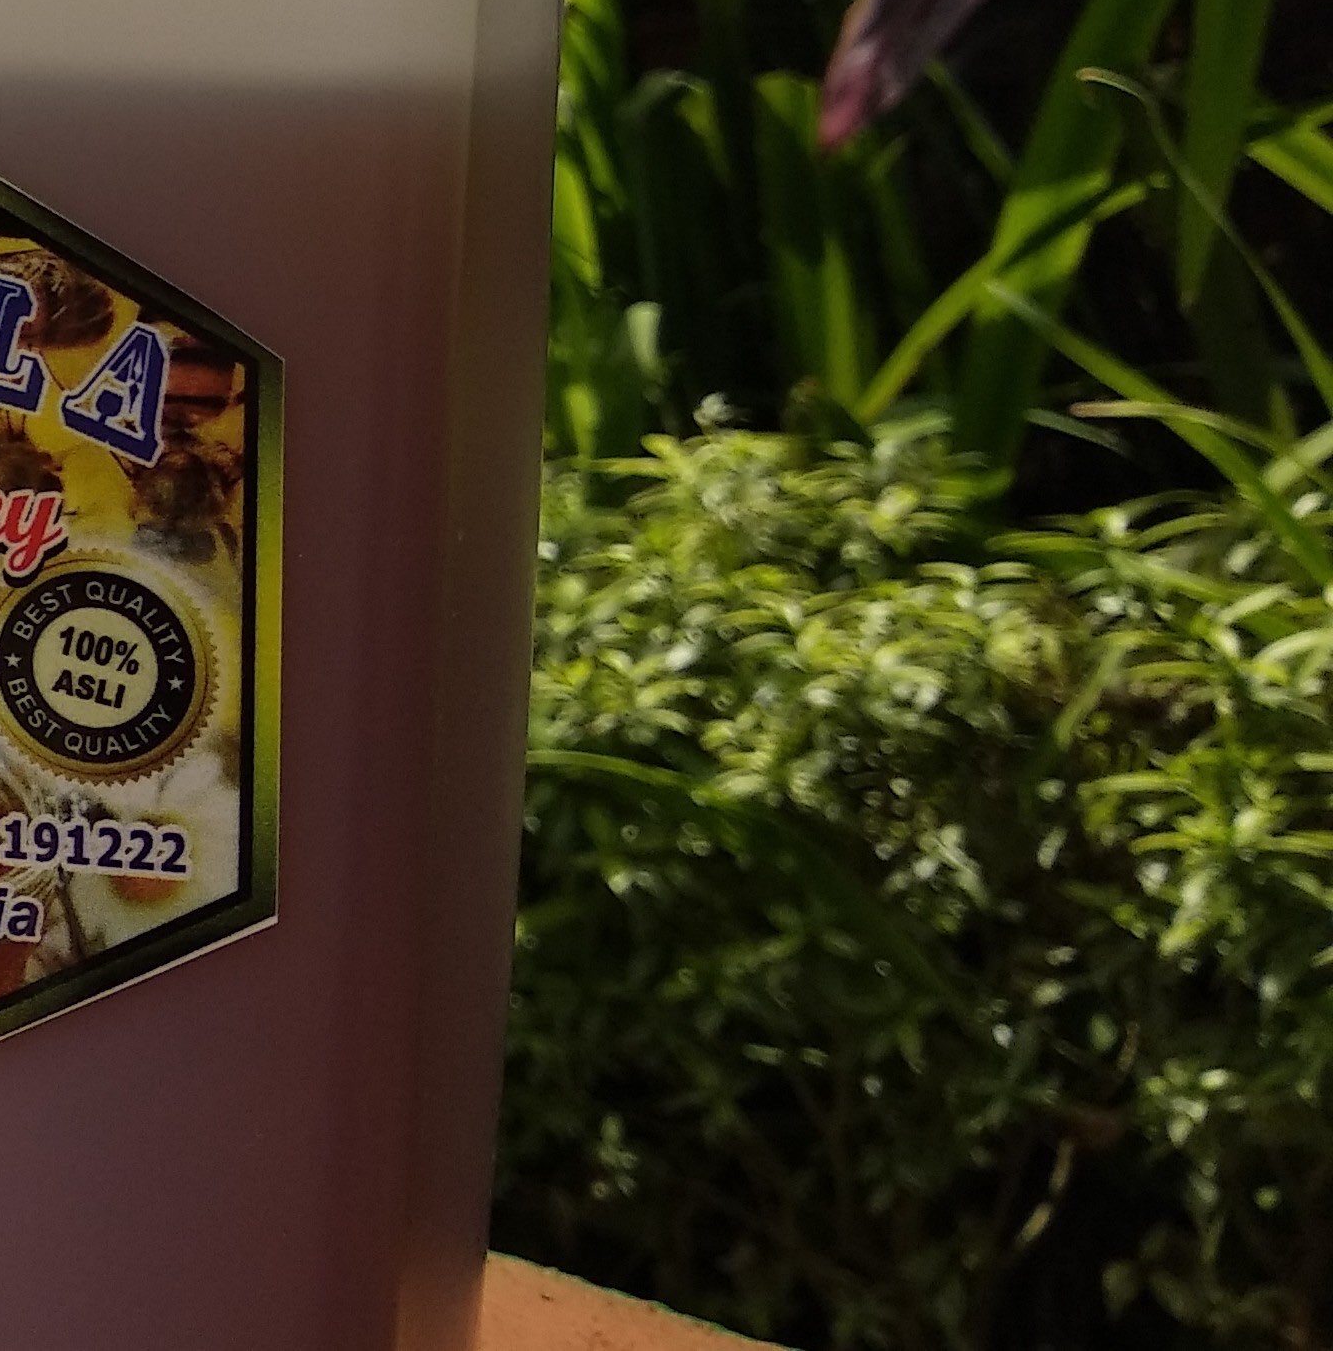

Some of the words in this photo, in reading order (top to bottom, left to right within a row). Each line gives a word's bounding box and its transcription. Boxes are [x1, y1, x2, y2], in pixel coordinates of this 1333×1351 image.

[12, 583, 72, 641] BEST
[85, 581, 186, 664] QUALITY
[59, 625, 140, 676] 100%
[7, 677, 62, 739] BEST
[64, 704, 172, 756] QUALITY
[51, 669, 126, 709] ASLI
